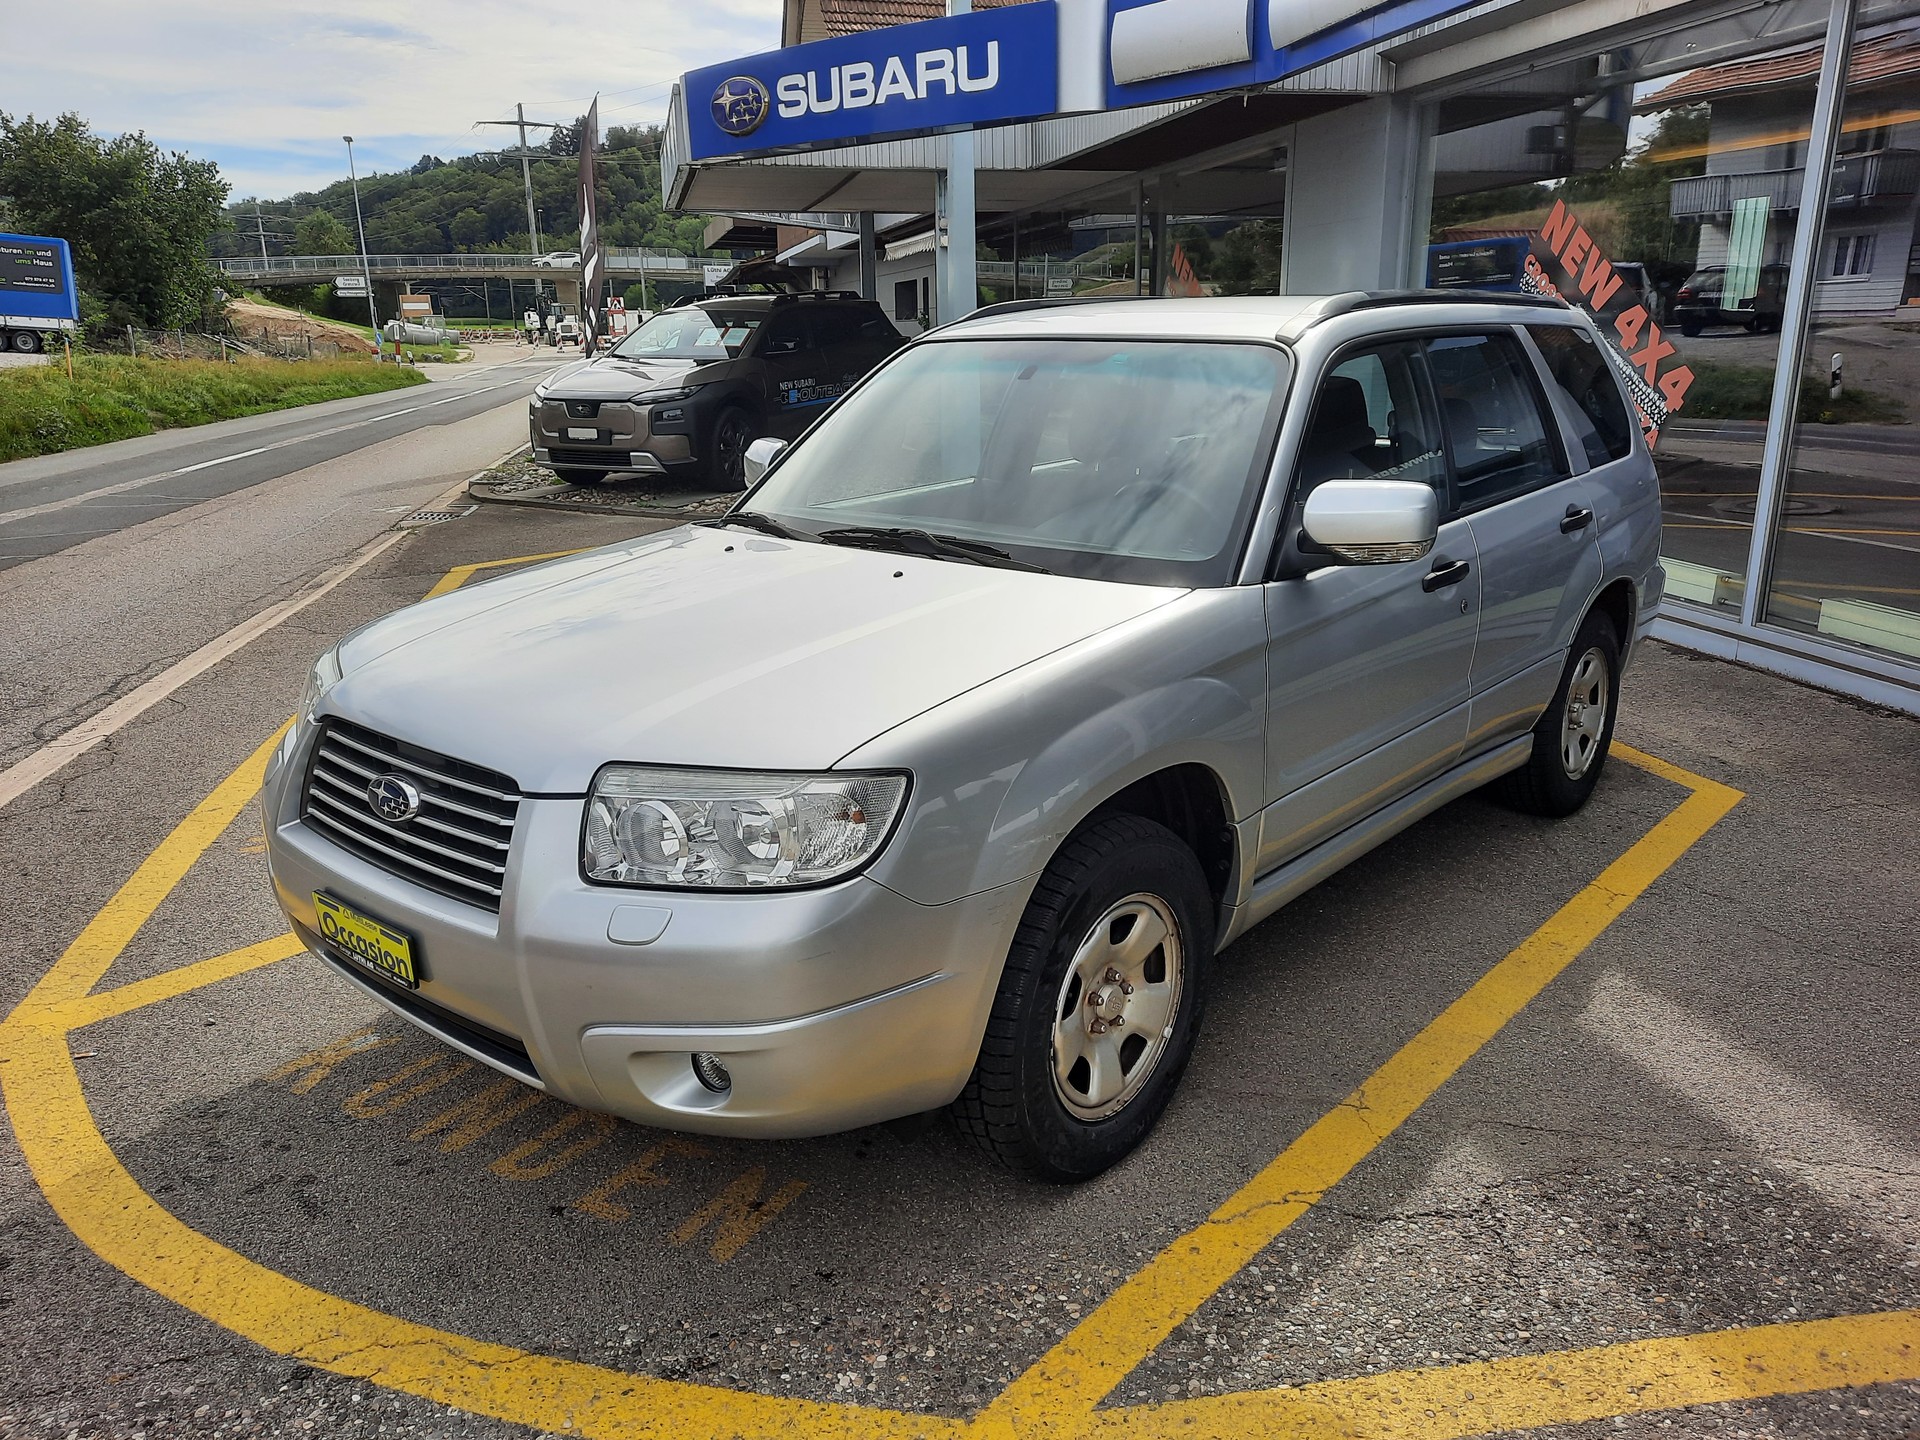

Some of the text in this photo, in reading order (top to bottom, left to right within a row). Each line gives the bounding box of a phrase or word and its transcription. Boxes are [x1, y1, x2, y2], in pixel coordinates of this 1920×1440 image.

[776, 40, 1000, 120] SUBARU
[14, 258, 54, 267] ums Haus
[24, 248, 35, 256] im
[36, 249, 53, 257] und
[1540, 198, 1696, 414] NEW 4X4
[779, 377, 816, 391] NEW SUBARU
[322, 911, 411, 980] Occasion
[262, 1024, 809, 1264] KUNDEN
